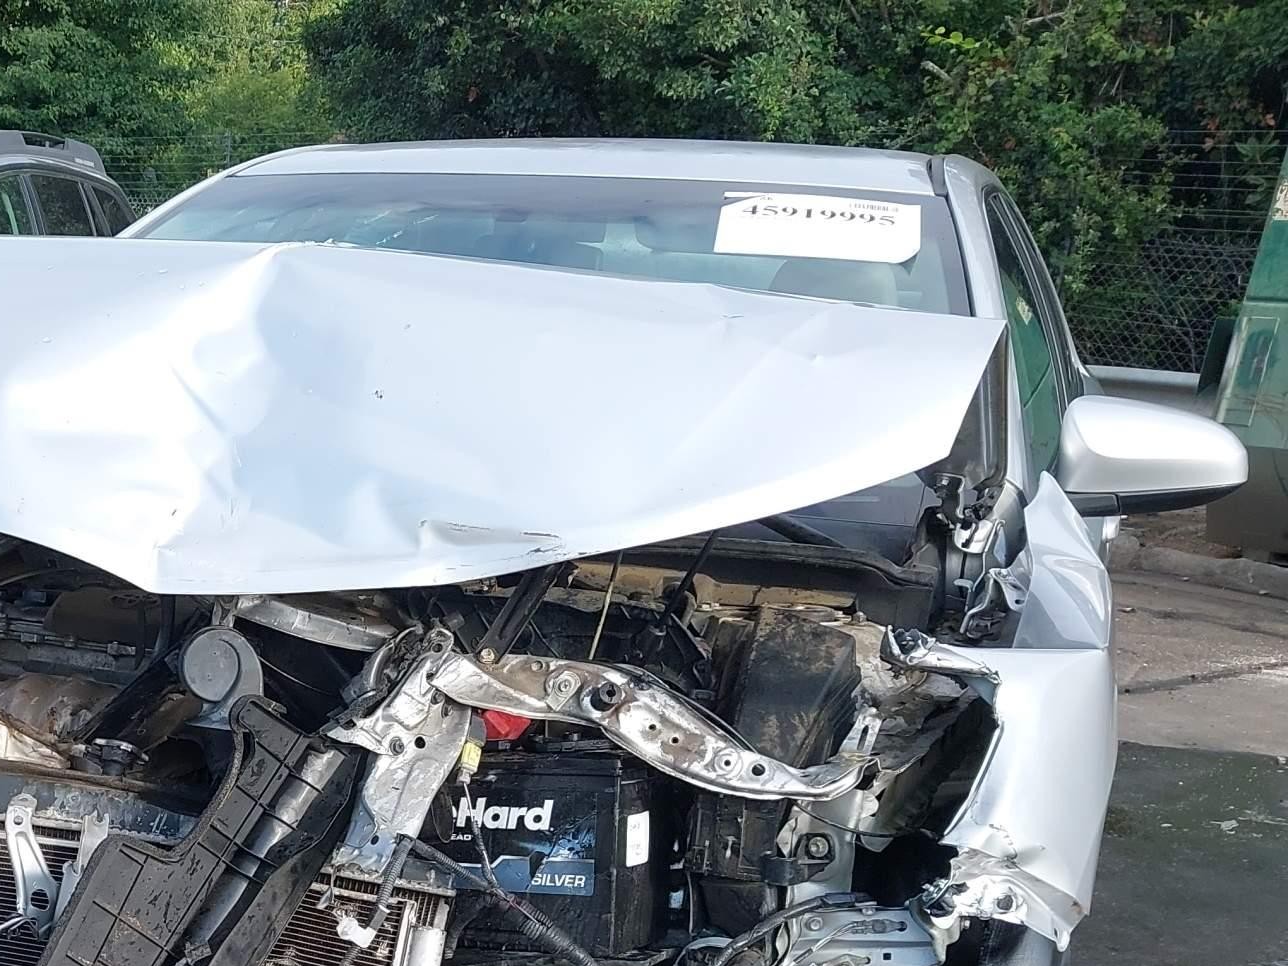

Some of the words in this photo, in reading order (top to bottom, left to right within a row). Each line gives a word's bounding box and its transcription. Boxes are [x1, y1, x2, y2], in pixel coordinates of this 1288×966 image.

[742, 204, 896, 226] 45919995
[452, 796, 554, 831] Hard.
[532, 873, 586, 888] SILVER
